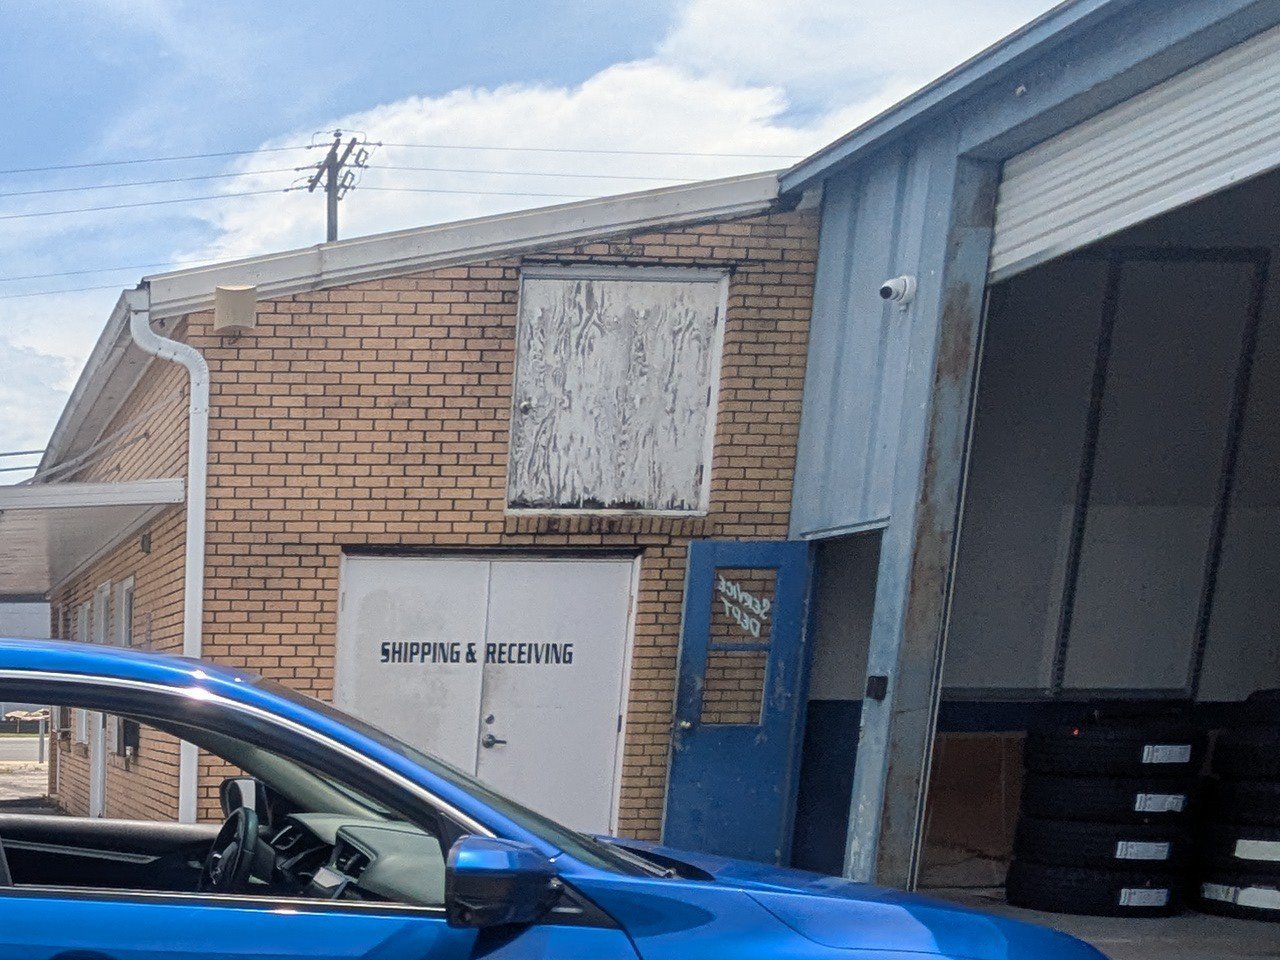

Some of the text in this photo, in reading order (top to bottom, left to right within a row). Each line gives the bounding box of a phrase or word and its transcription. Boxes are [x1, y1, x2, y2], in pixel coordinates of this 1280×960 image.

[380, 641, 574, 665] SHIPPING & RECEIVING
